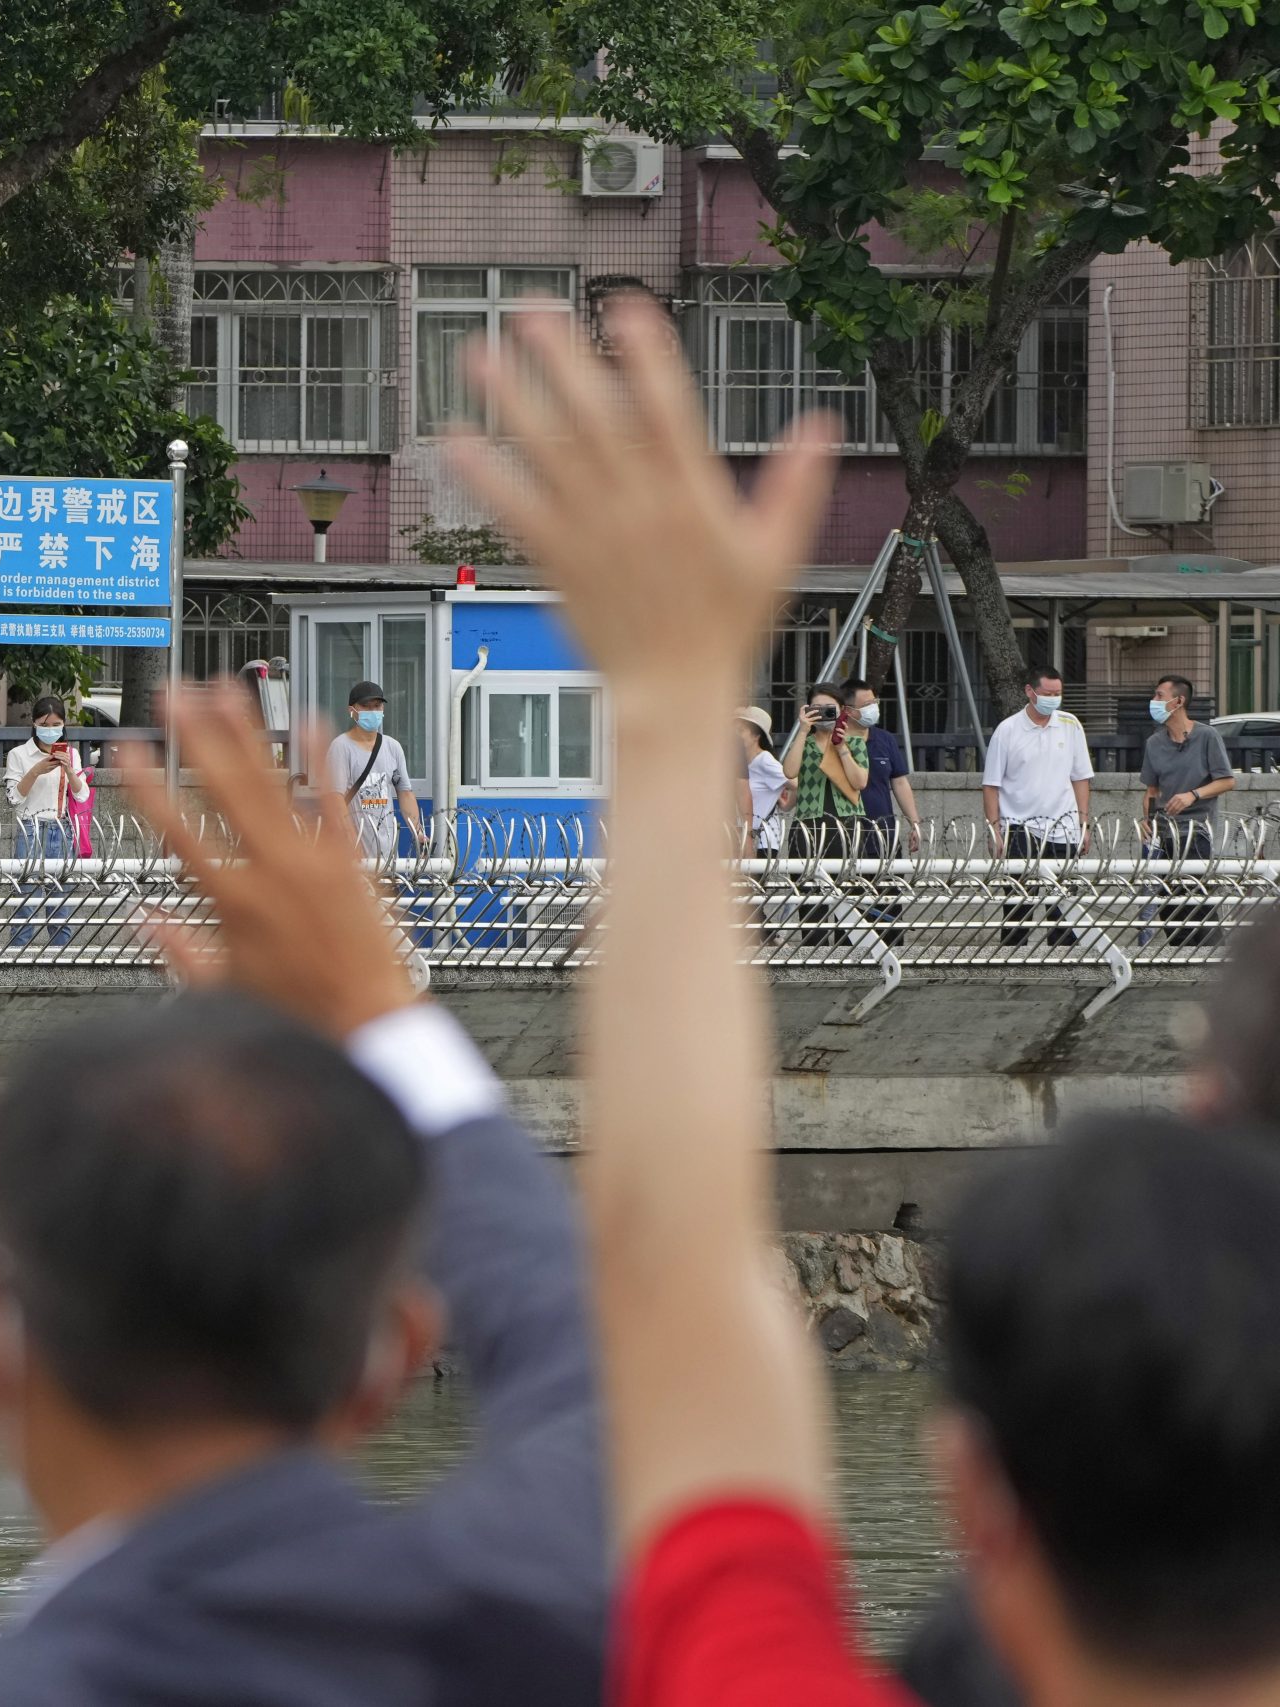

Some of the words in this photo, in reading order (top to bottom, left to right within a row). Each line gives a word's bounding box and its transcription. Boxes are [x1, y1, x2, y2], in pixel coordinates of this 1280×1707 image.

[35, 574, 115, 588] management
[117, 575, 160, 588] district
[3, 586, 13, 597] is
[16, 587, 75, 599] forbidden
[78, 588, 90, 600] to
[93, 588, 113, 600] the
[115, 591, 136, 601] sea
